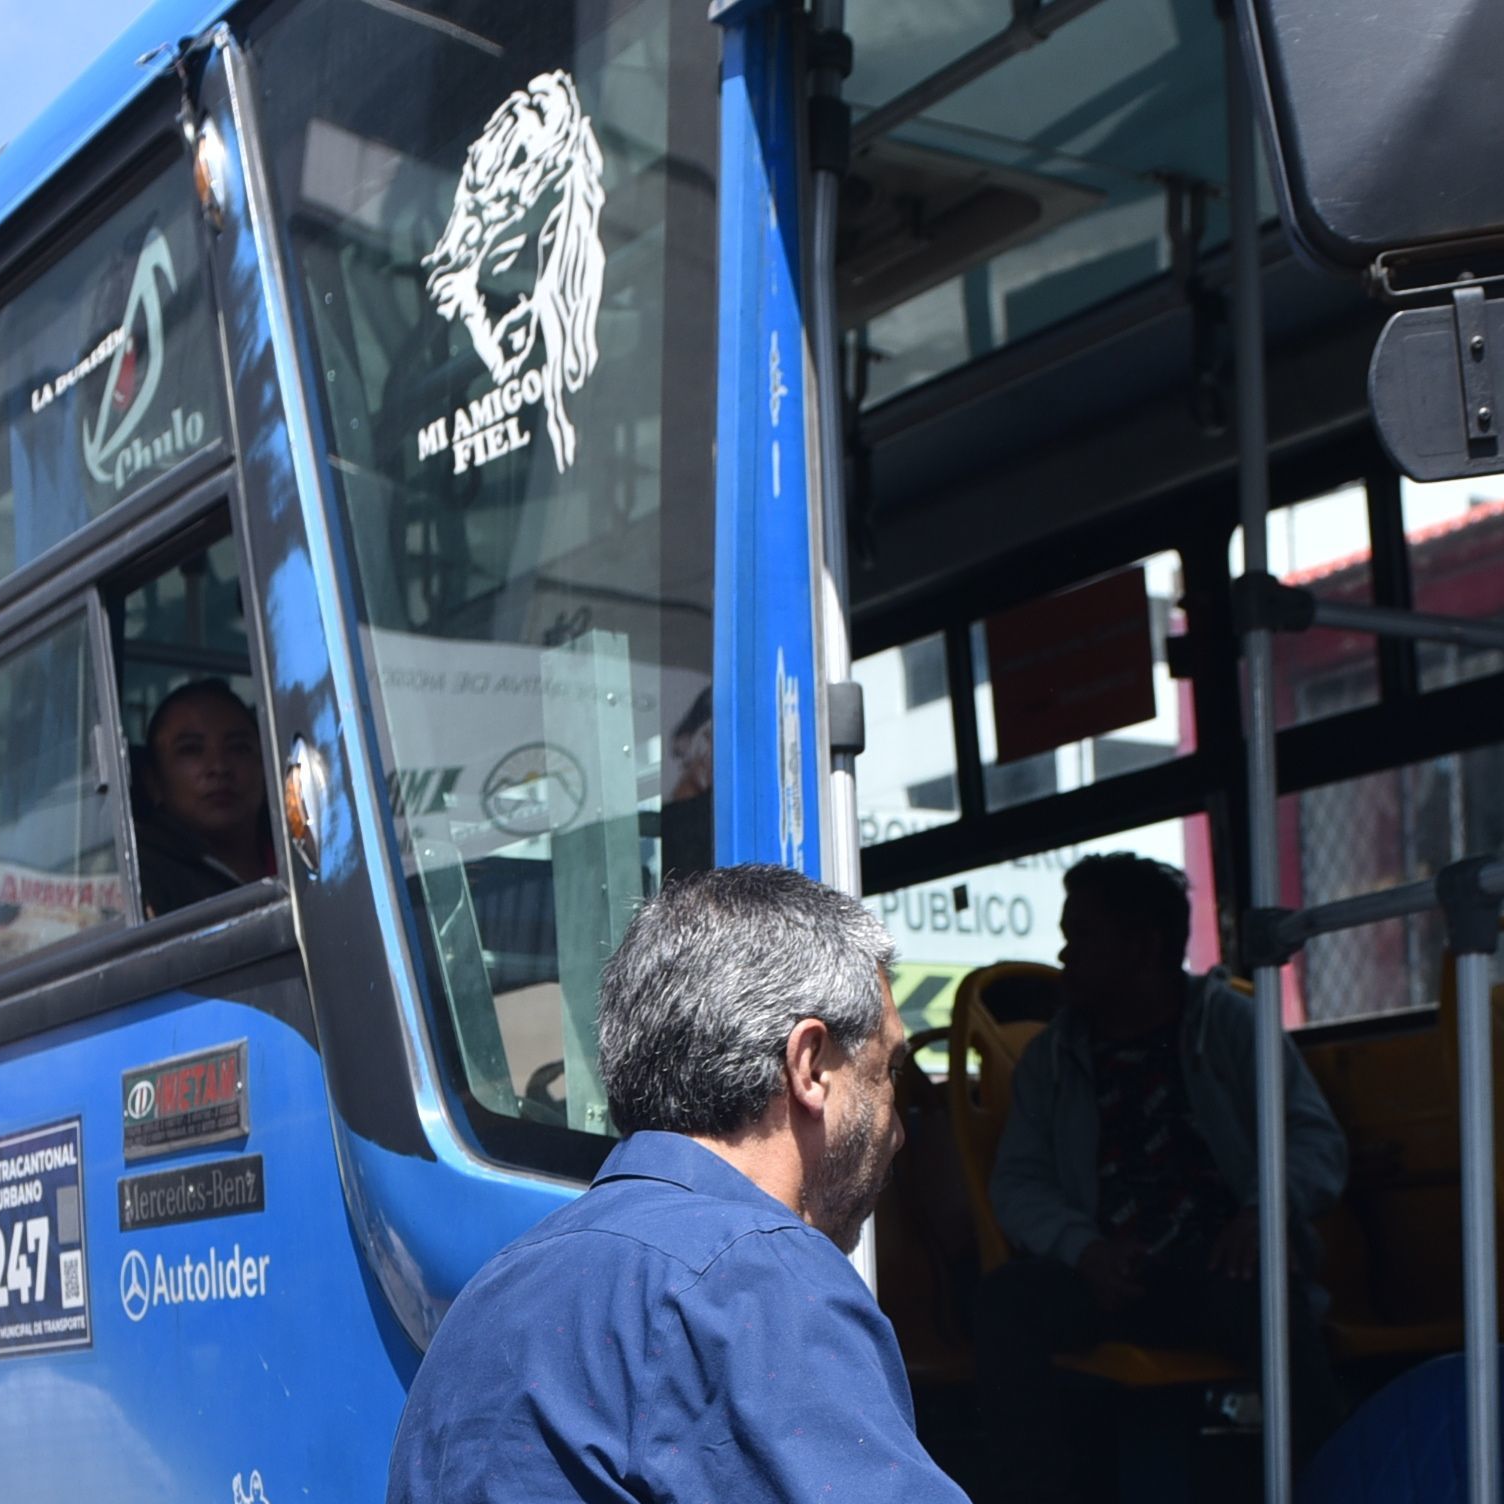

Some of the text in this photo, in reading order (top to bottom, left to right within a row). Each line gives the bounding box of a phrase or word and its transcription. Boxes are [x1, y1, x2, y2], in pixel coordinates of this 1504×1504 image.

[31, 382, 54, 413] LA
[418, 368, 543, 462] MI AMIGO
[452, 416, 531, 476] FIEL
[123, 1168, 258, 1224] Mercedes-Benz
[152, 1243, 270, 1307] Autolider
[0, 1322, 33, 1341] MUNICIPAL
[43, 1314, 86, 1334] TRANSPORTE
